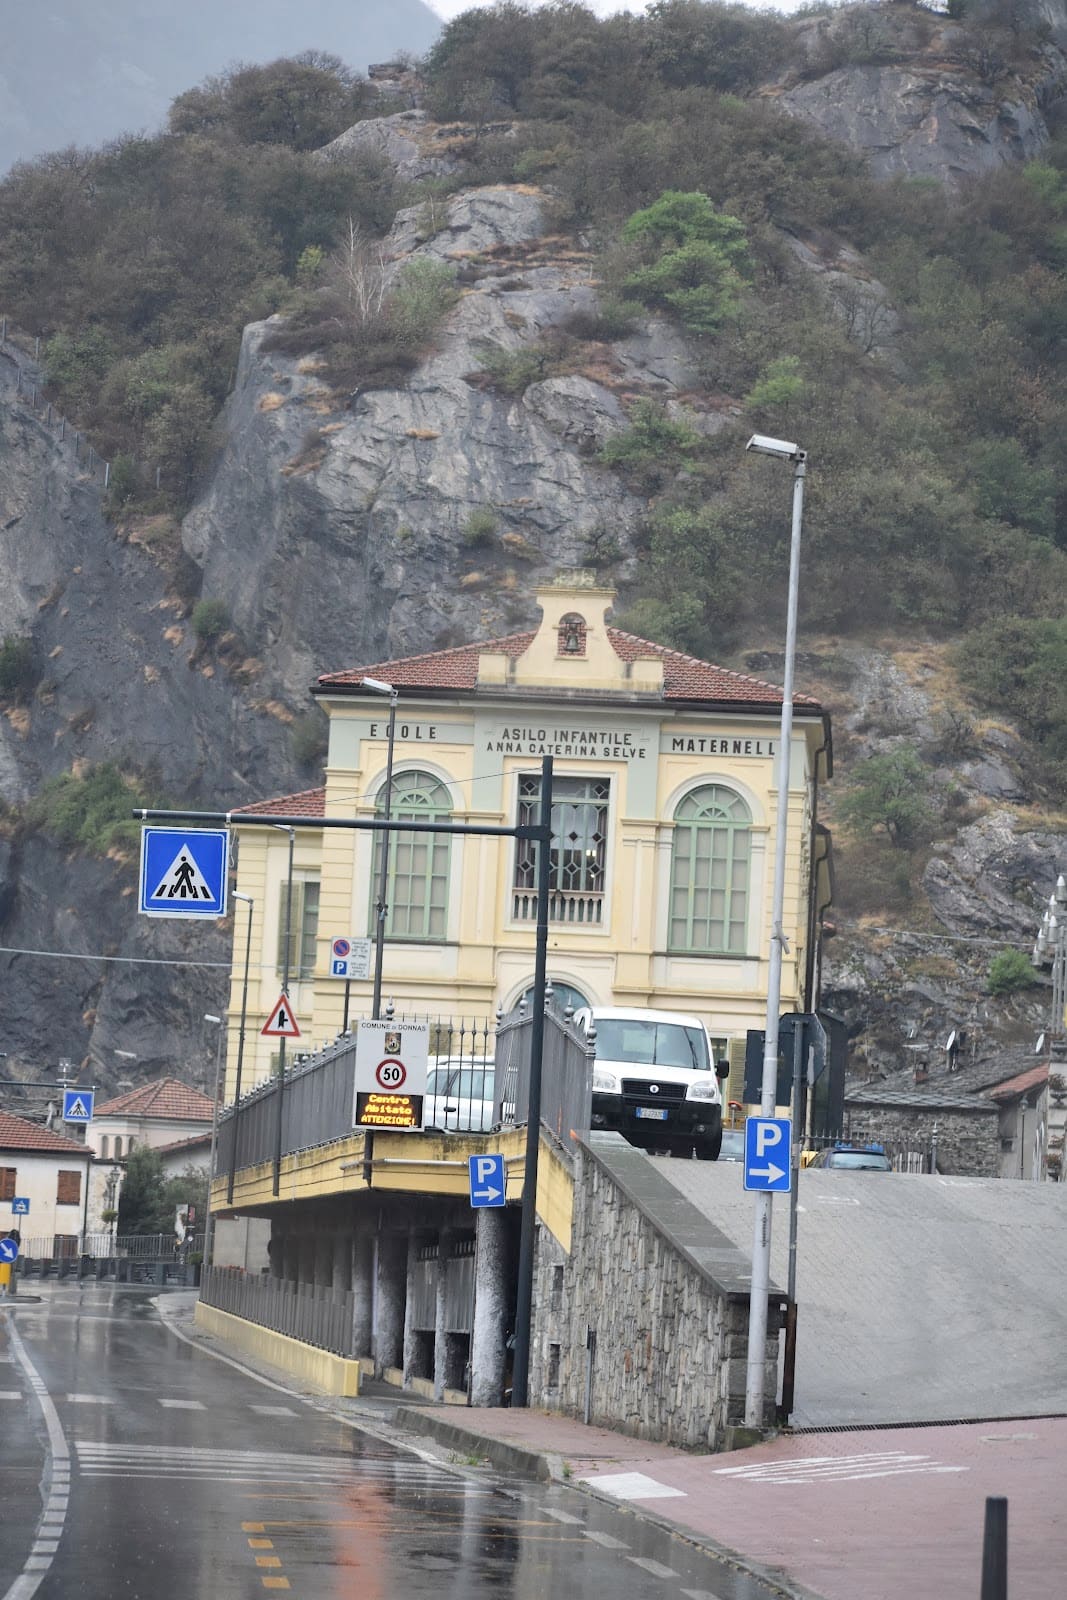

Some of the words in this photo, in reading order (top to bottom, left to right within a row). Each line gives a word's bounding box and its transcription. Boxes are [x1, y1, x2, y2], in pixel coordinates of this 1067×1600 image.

[502, 728, 547, 742] ASILO
[554, 729, 633, 746] INFANTILE
[486, 741, 523, 753] ANNA
[528, 743, 597, 757] CATERINA
[603, 747, 646, 759] SELVE
[672, 738, 775, 755] MATERNELL
[335, 961, 345, 974] P
[361, 1022, 391, 1030] COMUNE
[383, 1067, 400, 1081] 50
[368, 1094, 410, 1105] Centro
[364, 1104, 413, 1115] Abitato
[360, 1114, 416, 1126] ATTENZIONE!
[756, 1122, 782, 1157] P
[477, 1158, 497, 1184] P
